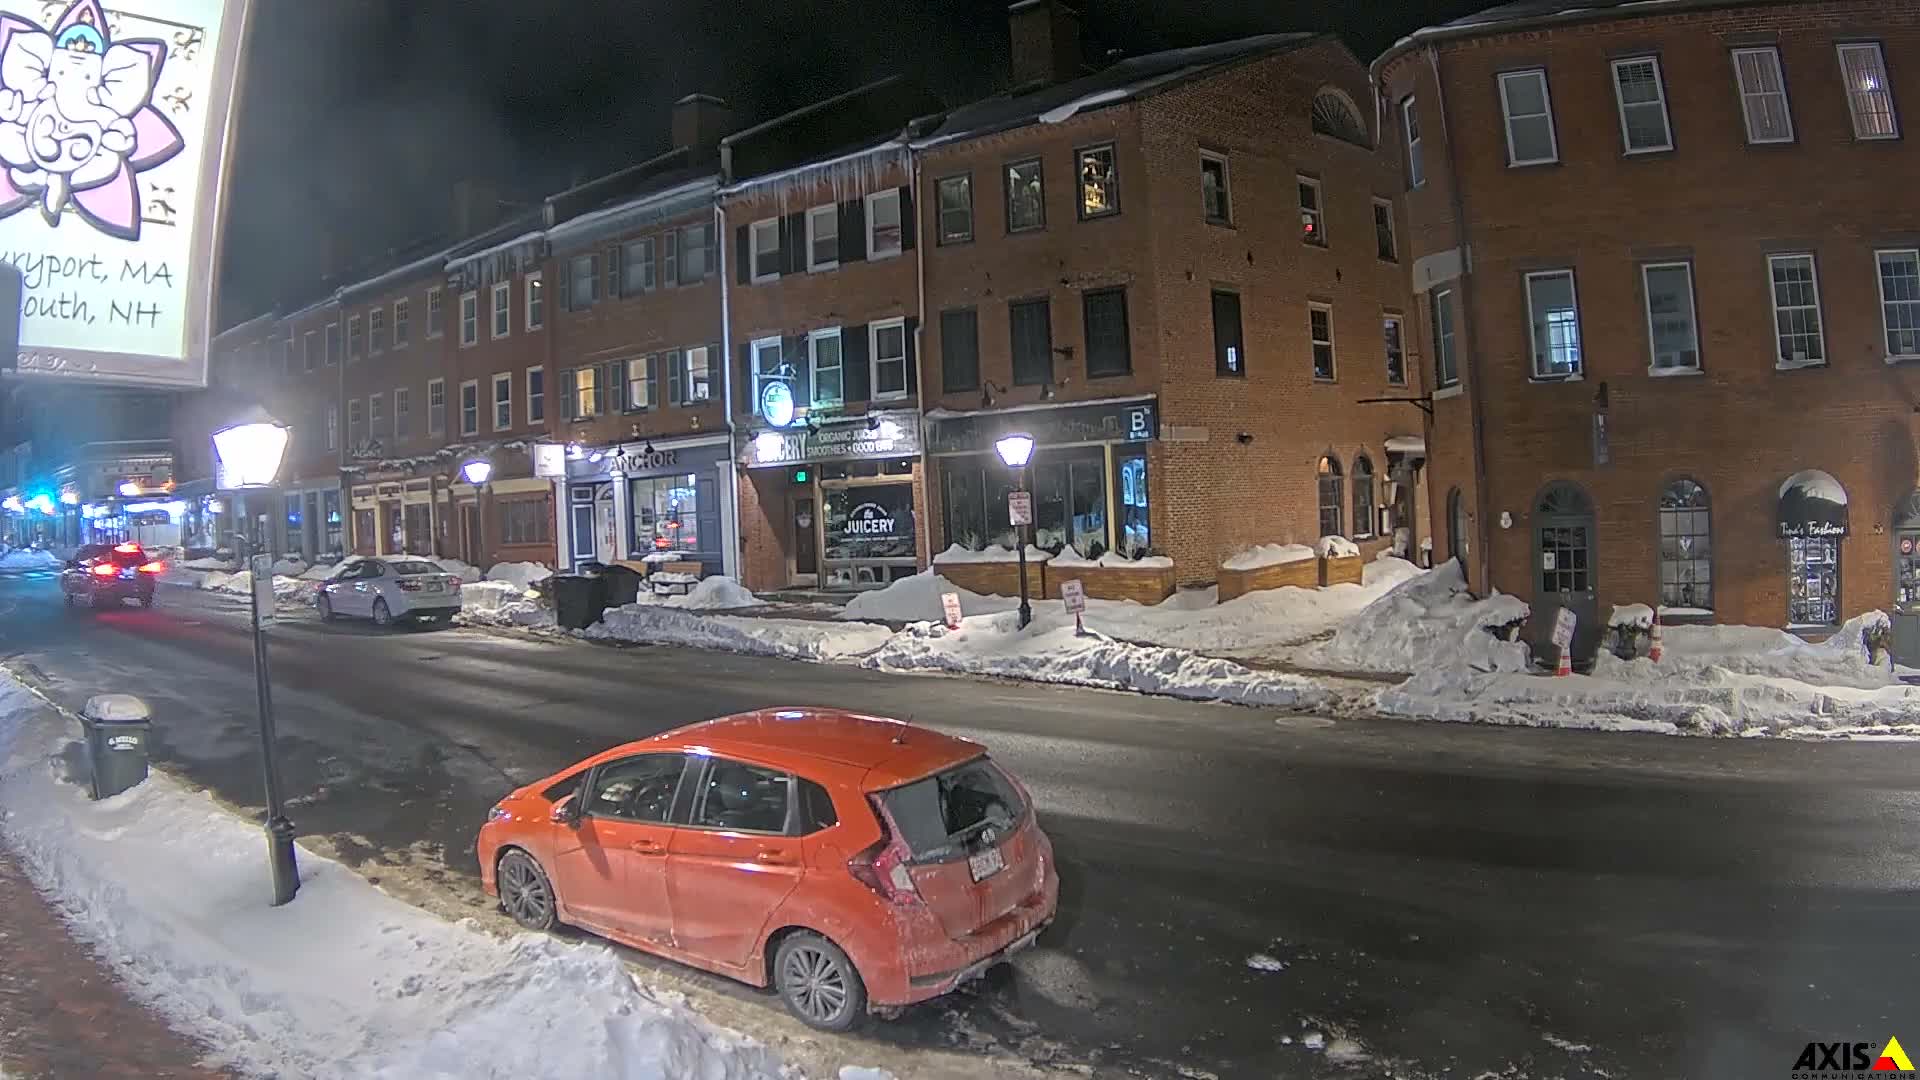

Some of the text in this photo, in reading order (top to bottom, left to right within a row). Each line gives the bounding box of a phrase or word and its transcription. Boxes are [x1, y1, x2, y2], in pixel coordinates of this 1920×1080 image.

[120, 259, 173, 288] MA
[22, 291, 162, 328] outh, NH
[609, 450, 677, 471] ANCHOR
[755, 432, 806, 462] CERY
[843, 518, 895, 534] JUICERY
